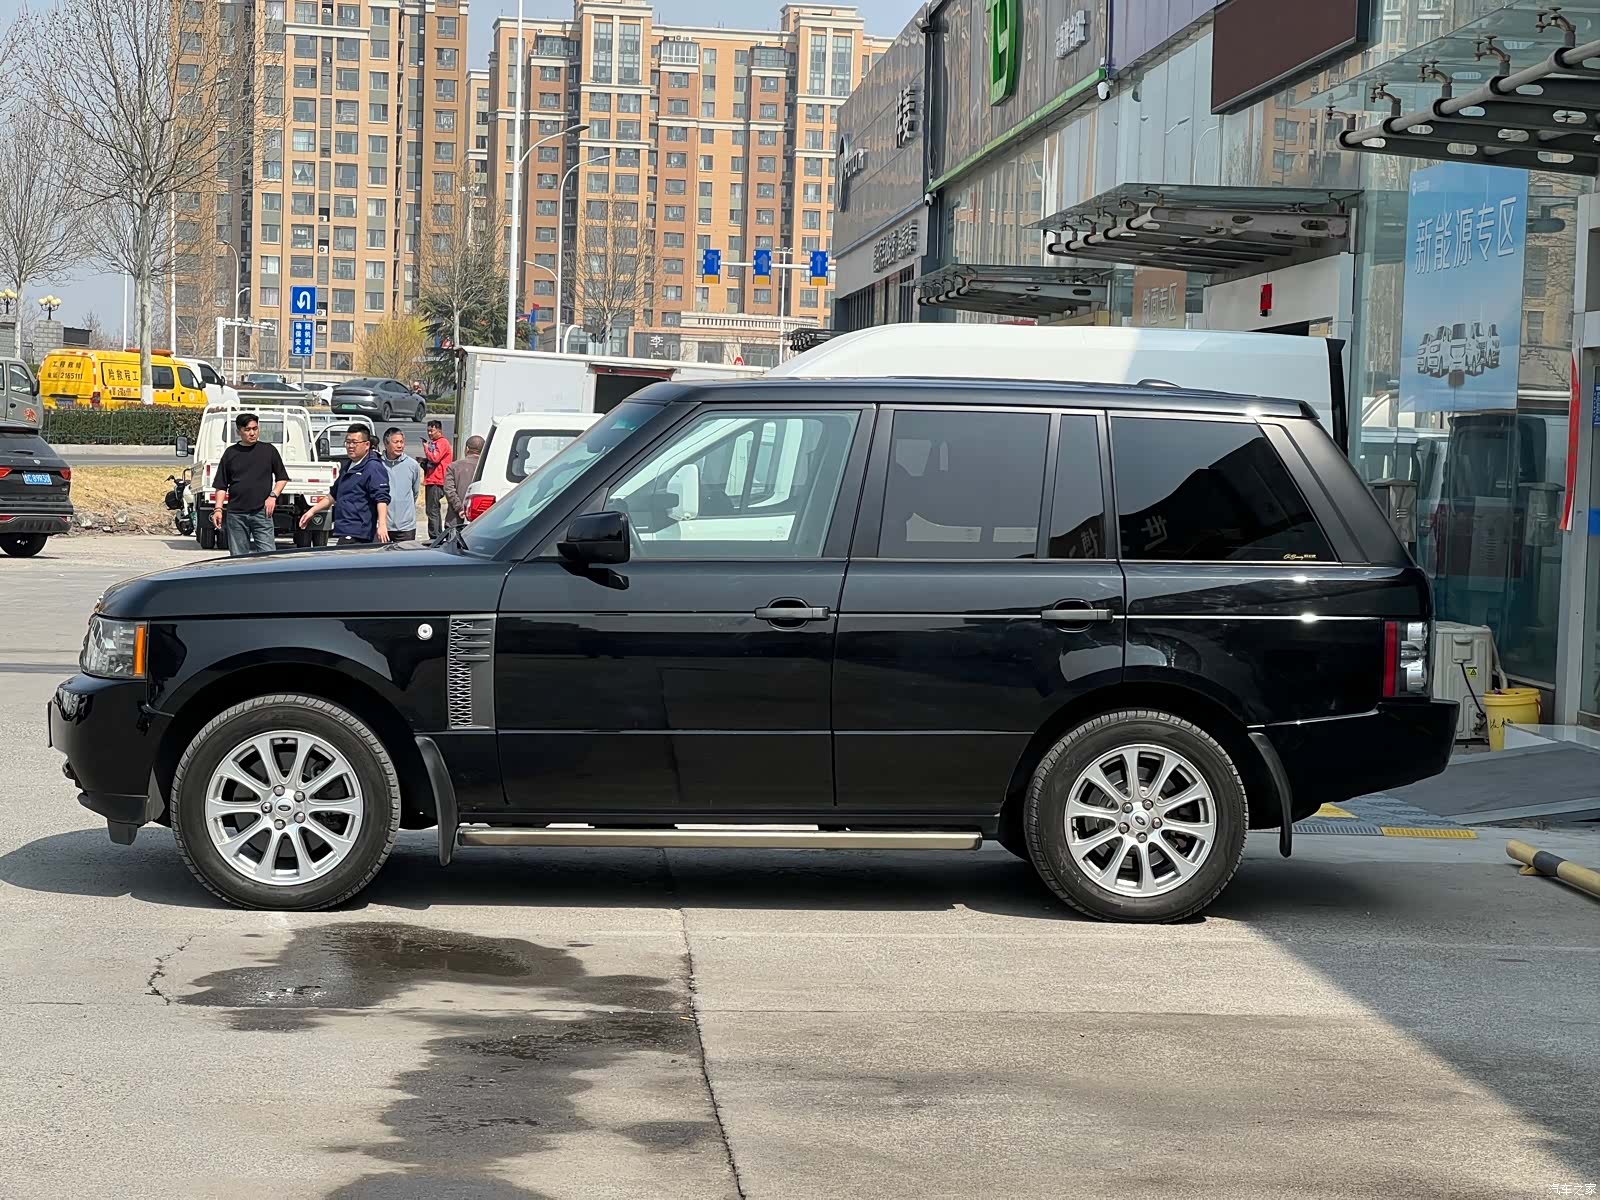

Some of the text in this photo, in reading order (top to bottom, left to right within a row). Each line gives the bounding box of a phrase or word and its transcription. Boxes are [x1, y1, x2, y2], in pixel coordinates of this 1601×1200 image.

[1415, 197, 1517, 274] 新能源专区
